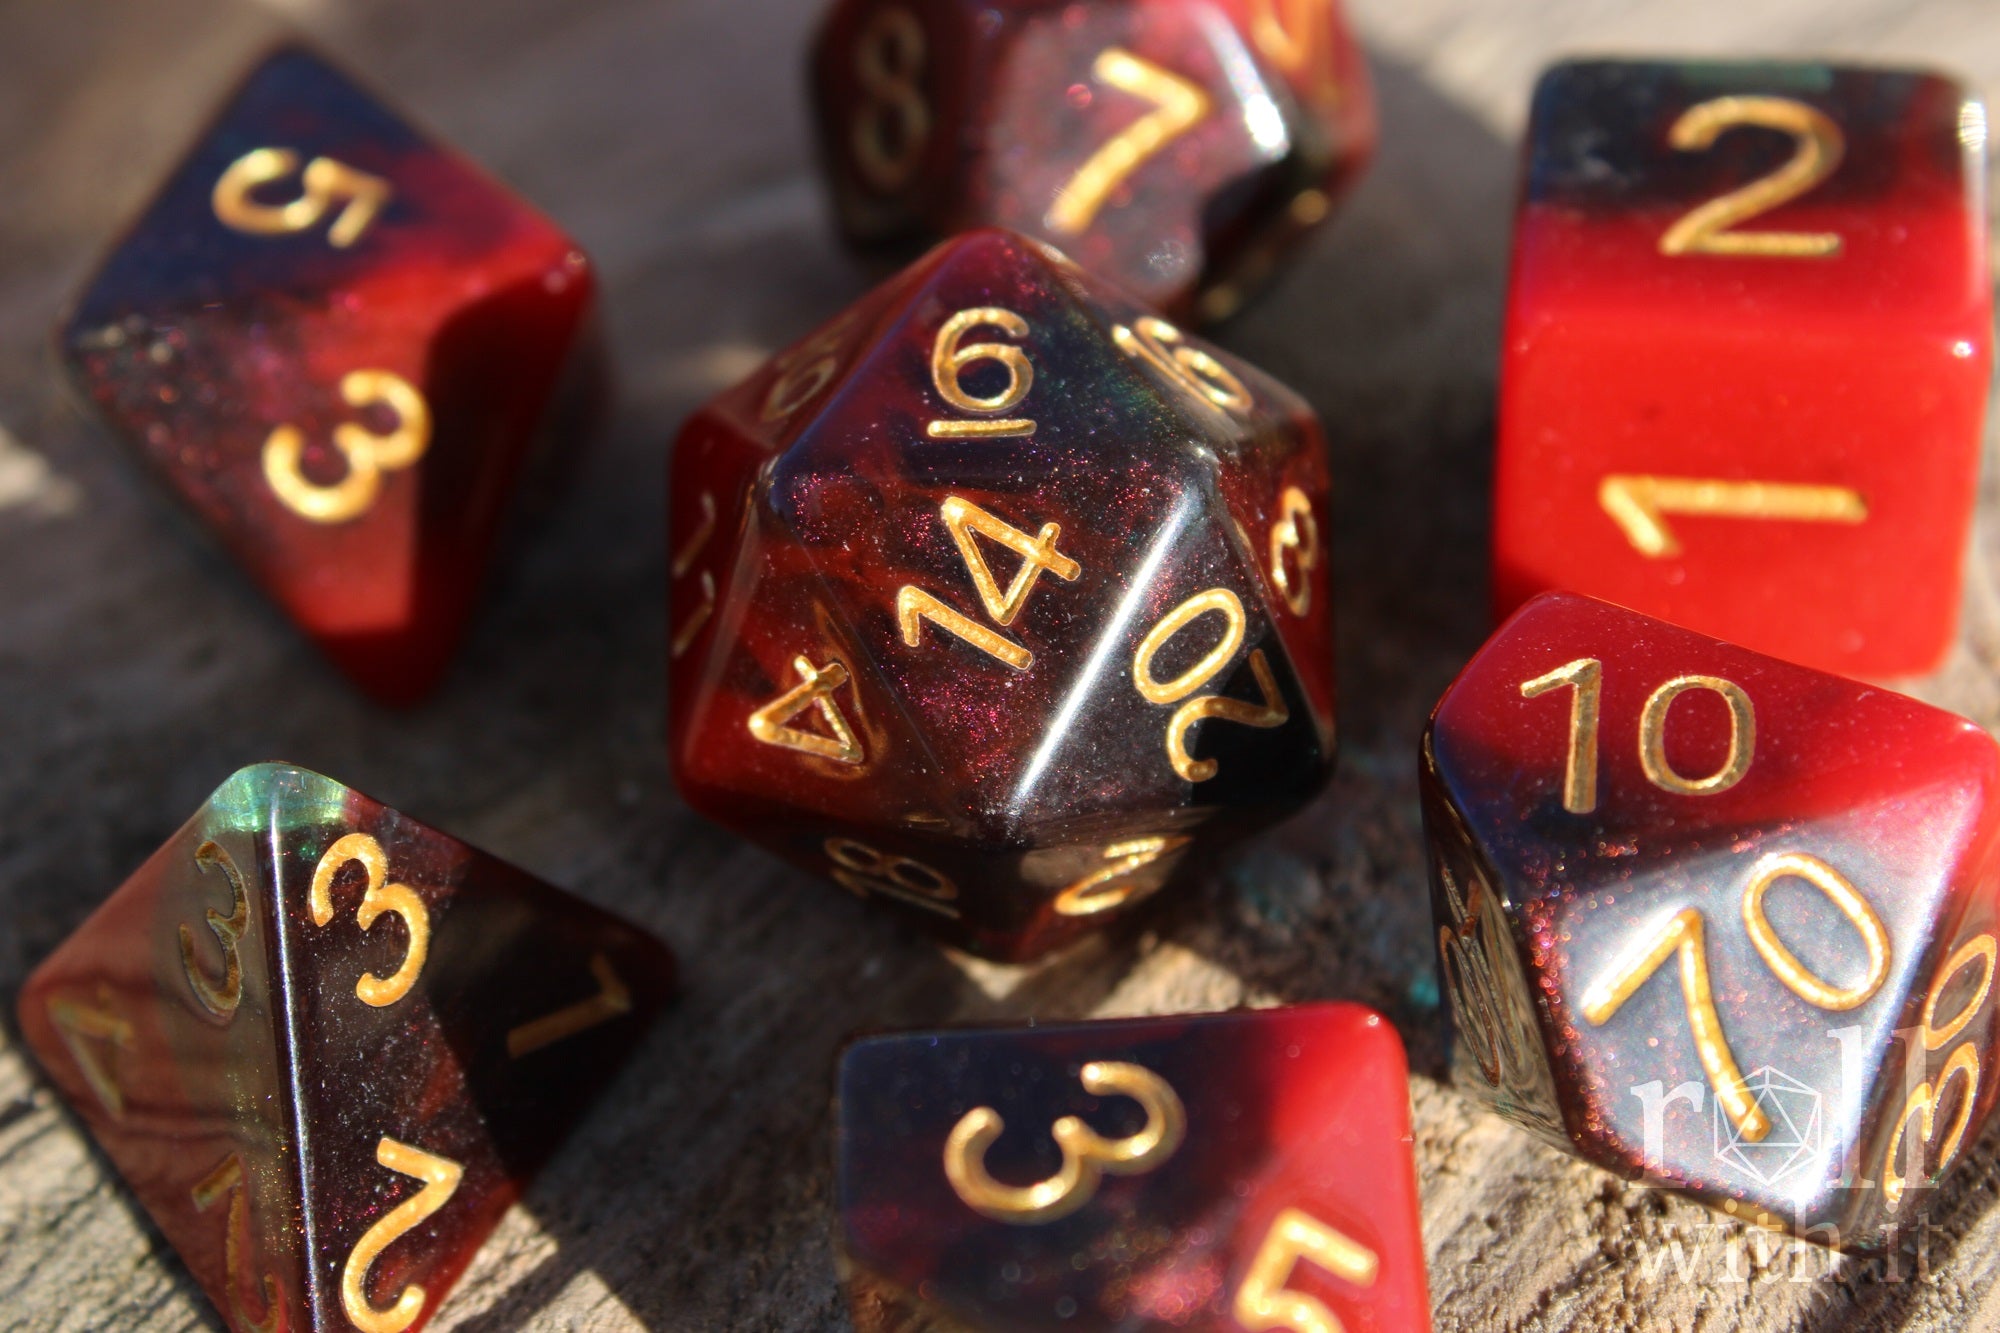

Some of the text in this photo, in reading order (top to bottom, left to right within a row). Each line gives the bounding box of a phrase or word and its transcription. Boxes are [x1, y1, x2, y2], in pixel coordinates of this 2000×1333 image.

[211, 146, 393, 248] 5
[1046, 47, 1206, 235] 7
[1659, 95, 1846, 256] 2
[261, 368, 433, 524] 3
[928, 306, 1037, 437] 6
[898, 496, 1082, 670] 14
[1599, 474, 1868, 558] 1
[749, 655, 867, 763] 4
[1133, 588, 1290, 783] 20
[1520, 657, 1757, 814] 10
[179, 840, 251, 1027] 3
[308, 832, 430, 1008] 3
[824, 837, 962, 919] 18
[507, 950, 633, 1060] 1
[1580, 852, 1892, 1143] 70
[1883, 933, 1998, 1203] 30
[943, 1060, 1188, 1227] 3
[342, 1136, 464, 1333] 2
